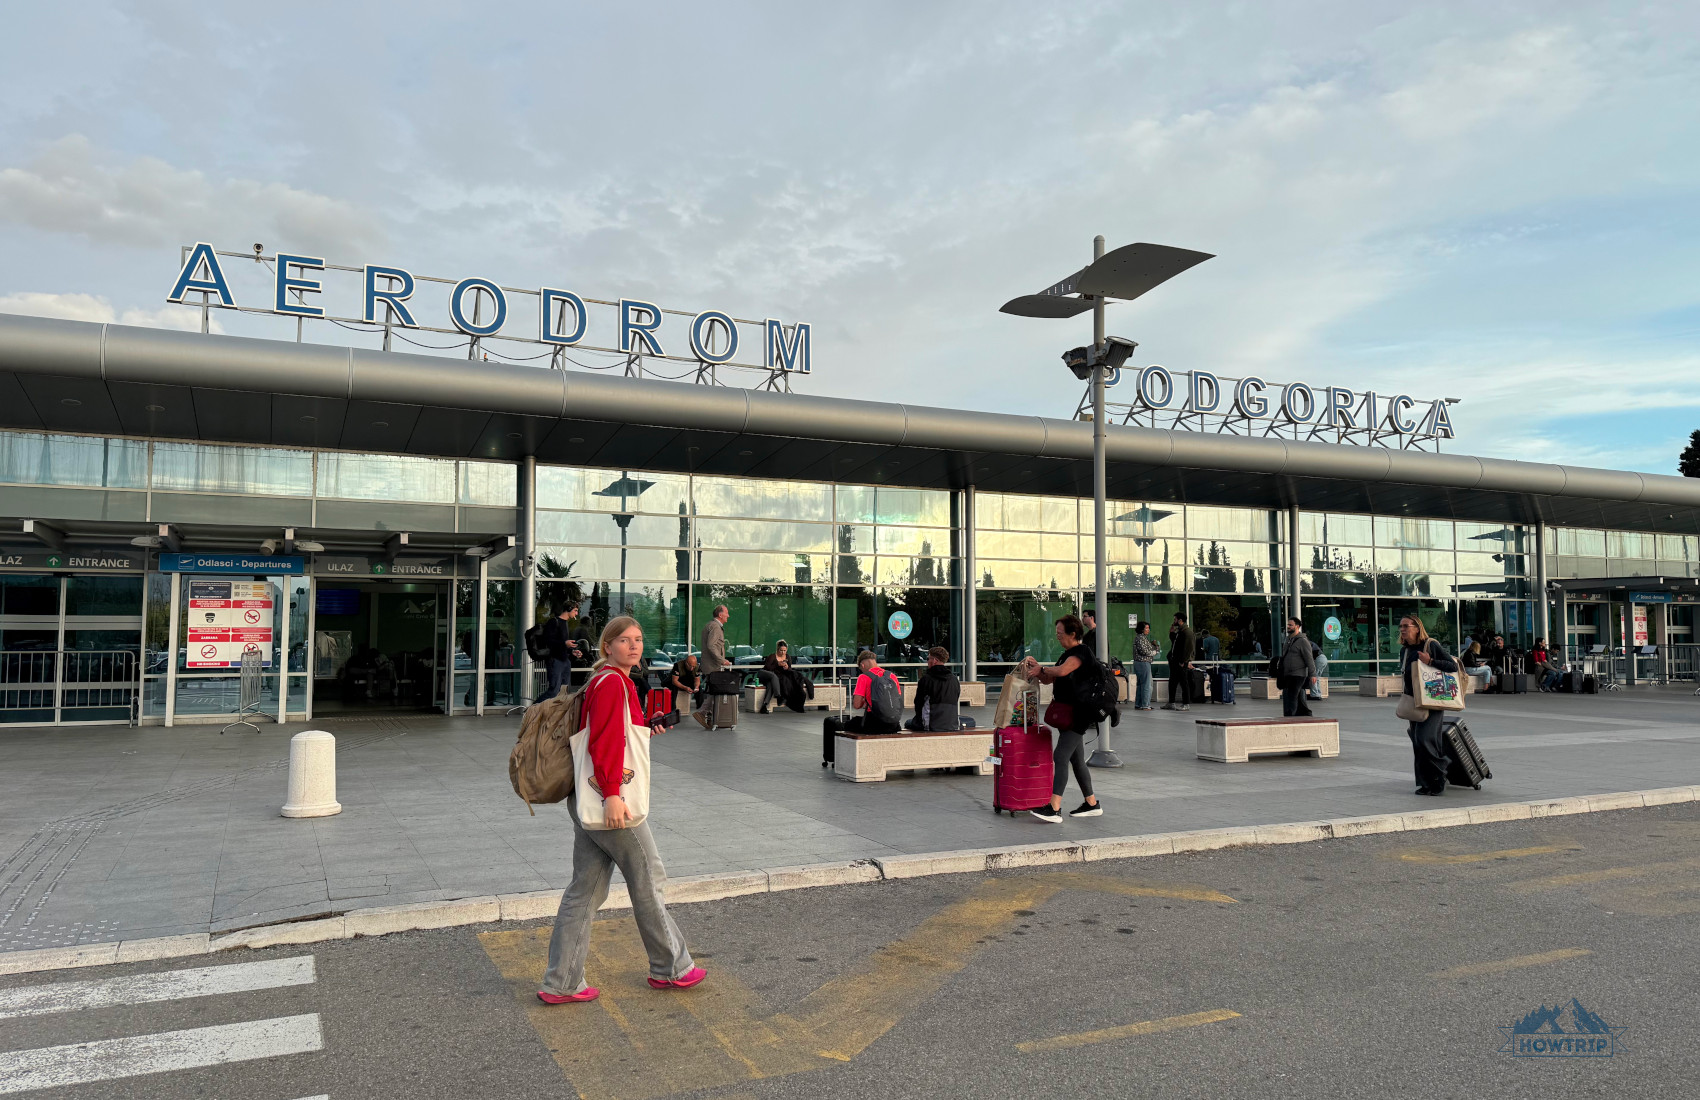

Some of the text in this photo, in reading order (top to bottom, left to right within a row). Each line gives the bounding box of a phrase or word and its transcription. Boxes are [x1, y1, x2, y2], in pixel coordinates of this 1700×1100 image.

[166, 242, 811, 374] AERODROM
[0, 556, 130, 568] LAZ ENTRANCE
[198, 559, 233, 567] Odlasci
[241, 560, 292, 569] Departures
[327, 563, 442, 574] ULAZ ENTRANCE
